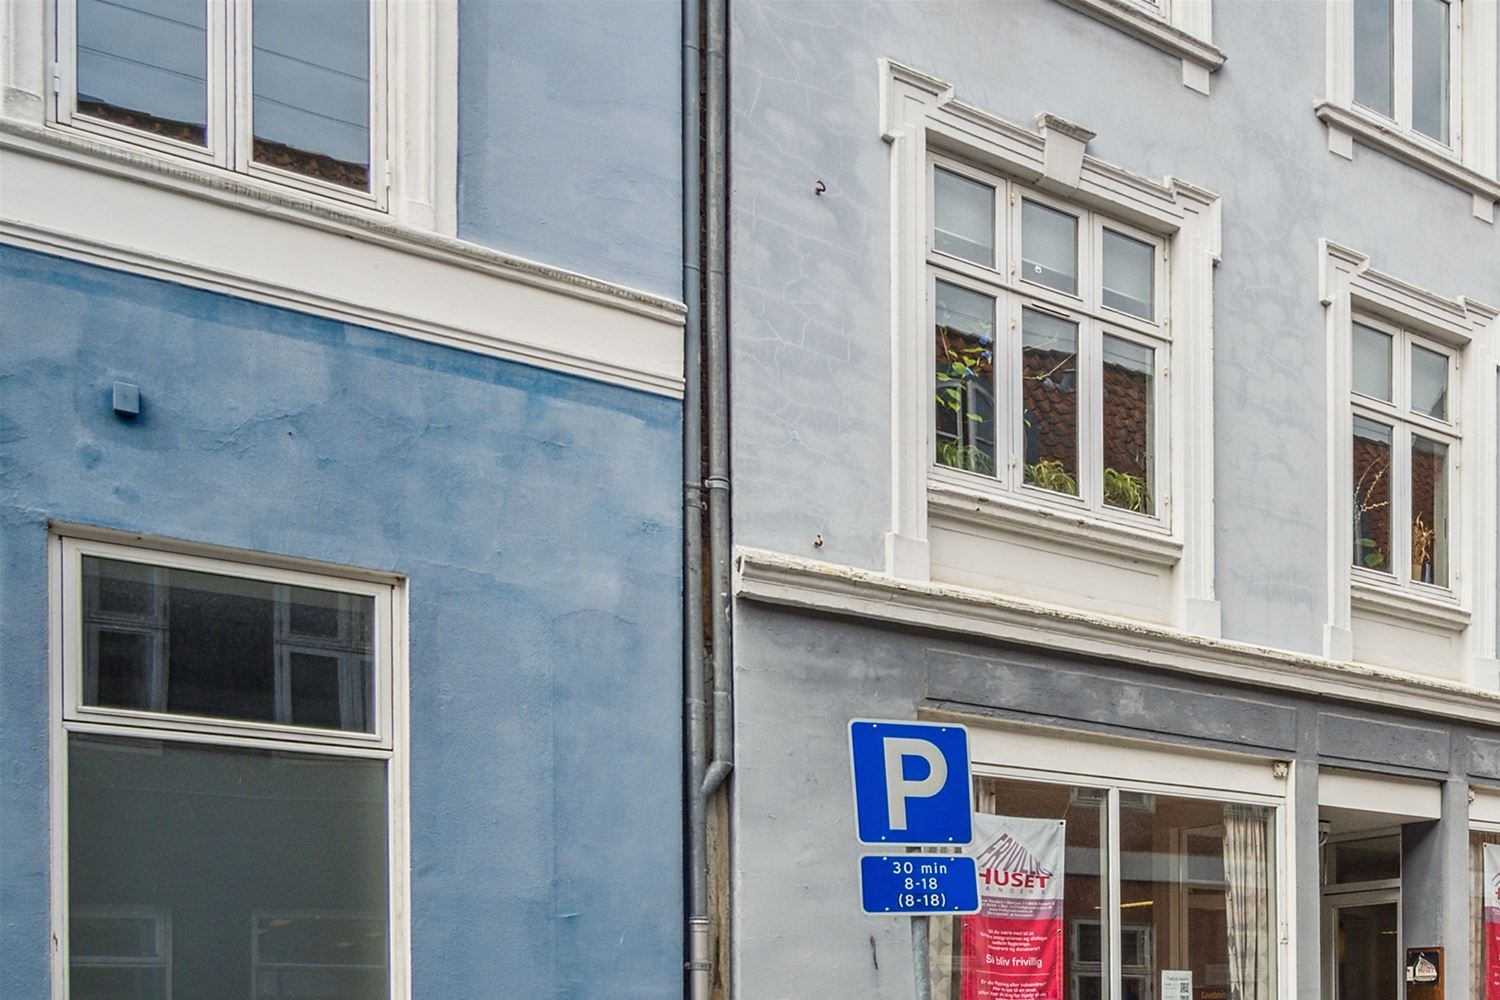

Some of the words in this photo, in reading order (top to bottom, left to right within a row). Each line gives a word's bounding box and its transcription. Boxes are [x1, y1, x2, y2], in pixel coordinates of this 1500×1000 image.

[883, 737, 947, 830] P
[893, 861, 913, 874] 30
[921, 862, 947, 874] min
[904, 877, 938, 890] 8-18
[898, 893, 946, 908] (8-18)
